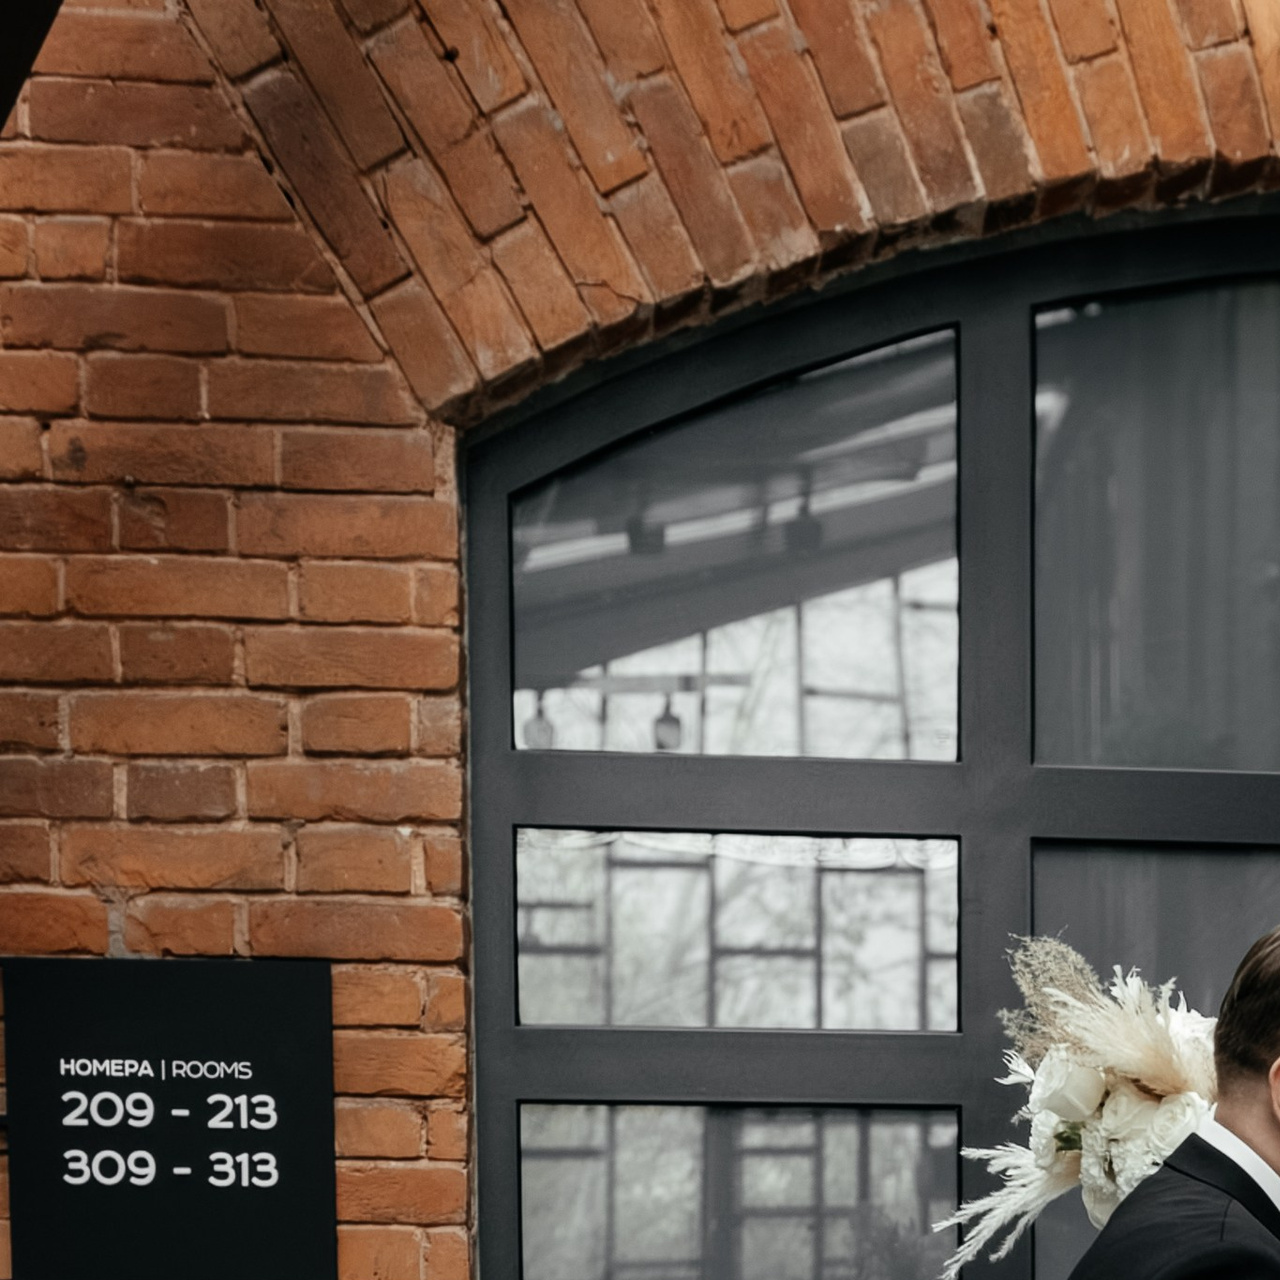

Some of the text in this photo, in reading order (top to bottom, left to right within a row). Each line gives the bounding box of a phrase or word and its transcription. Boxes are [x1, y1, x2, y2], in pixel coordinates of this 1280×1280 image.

[59, 1057, 155, 1078] НОМЕРА
[171, 1060, 253, 1080] ROOMS
[60, 1090, 155, 1128] 209
[206, 1093, 278, 1131] 213
[62, 1148, 157, 1186] 309
[207, 1151, 279, 1188] 313
